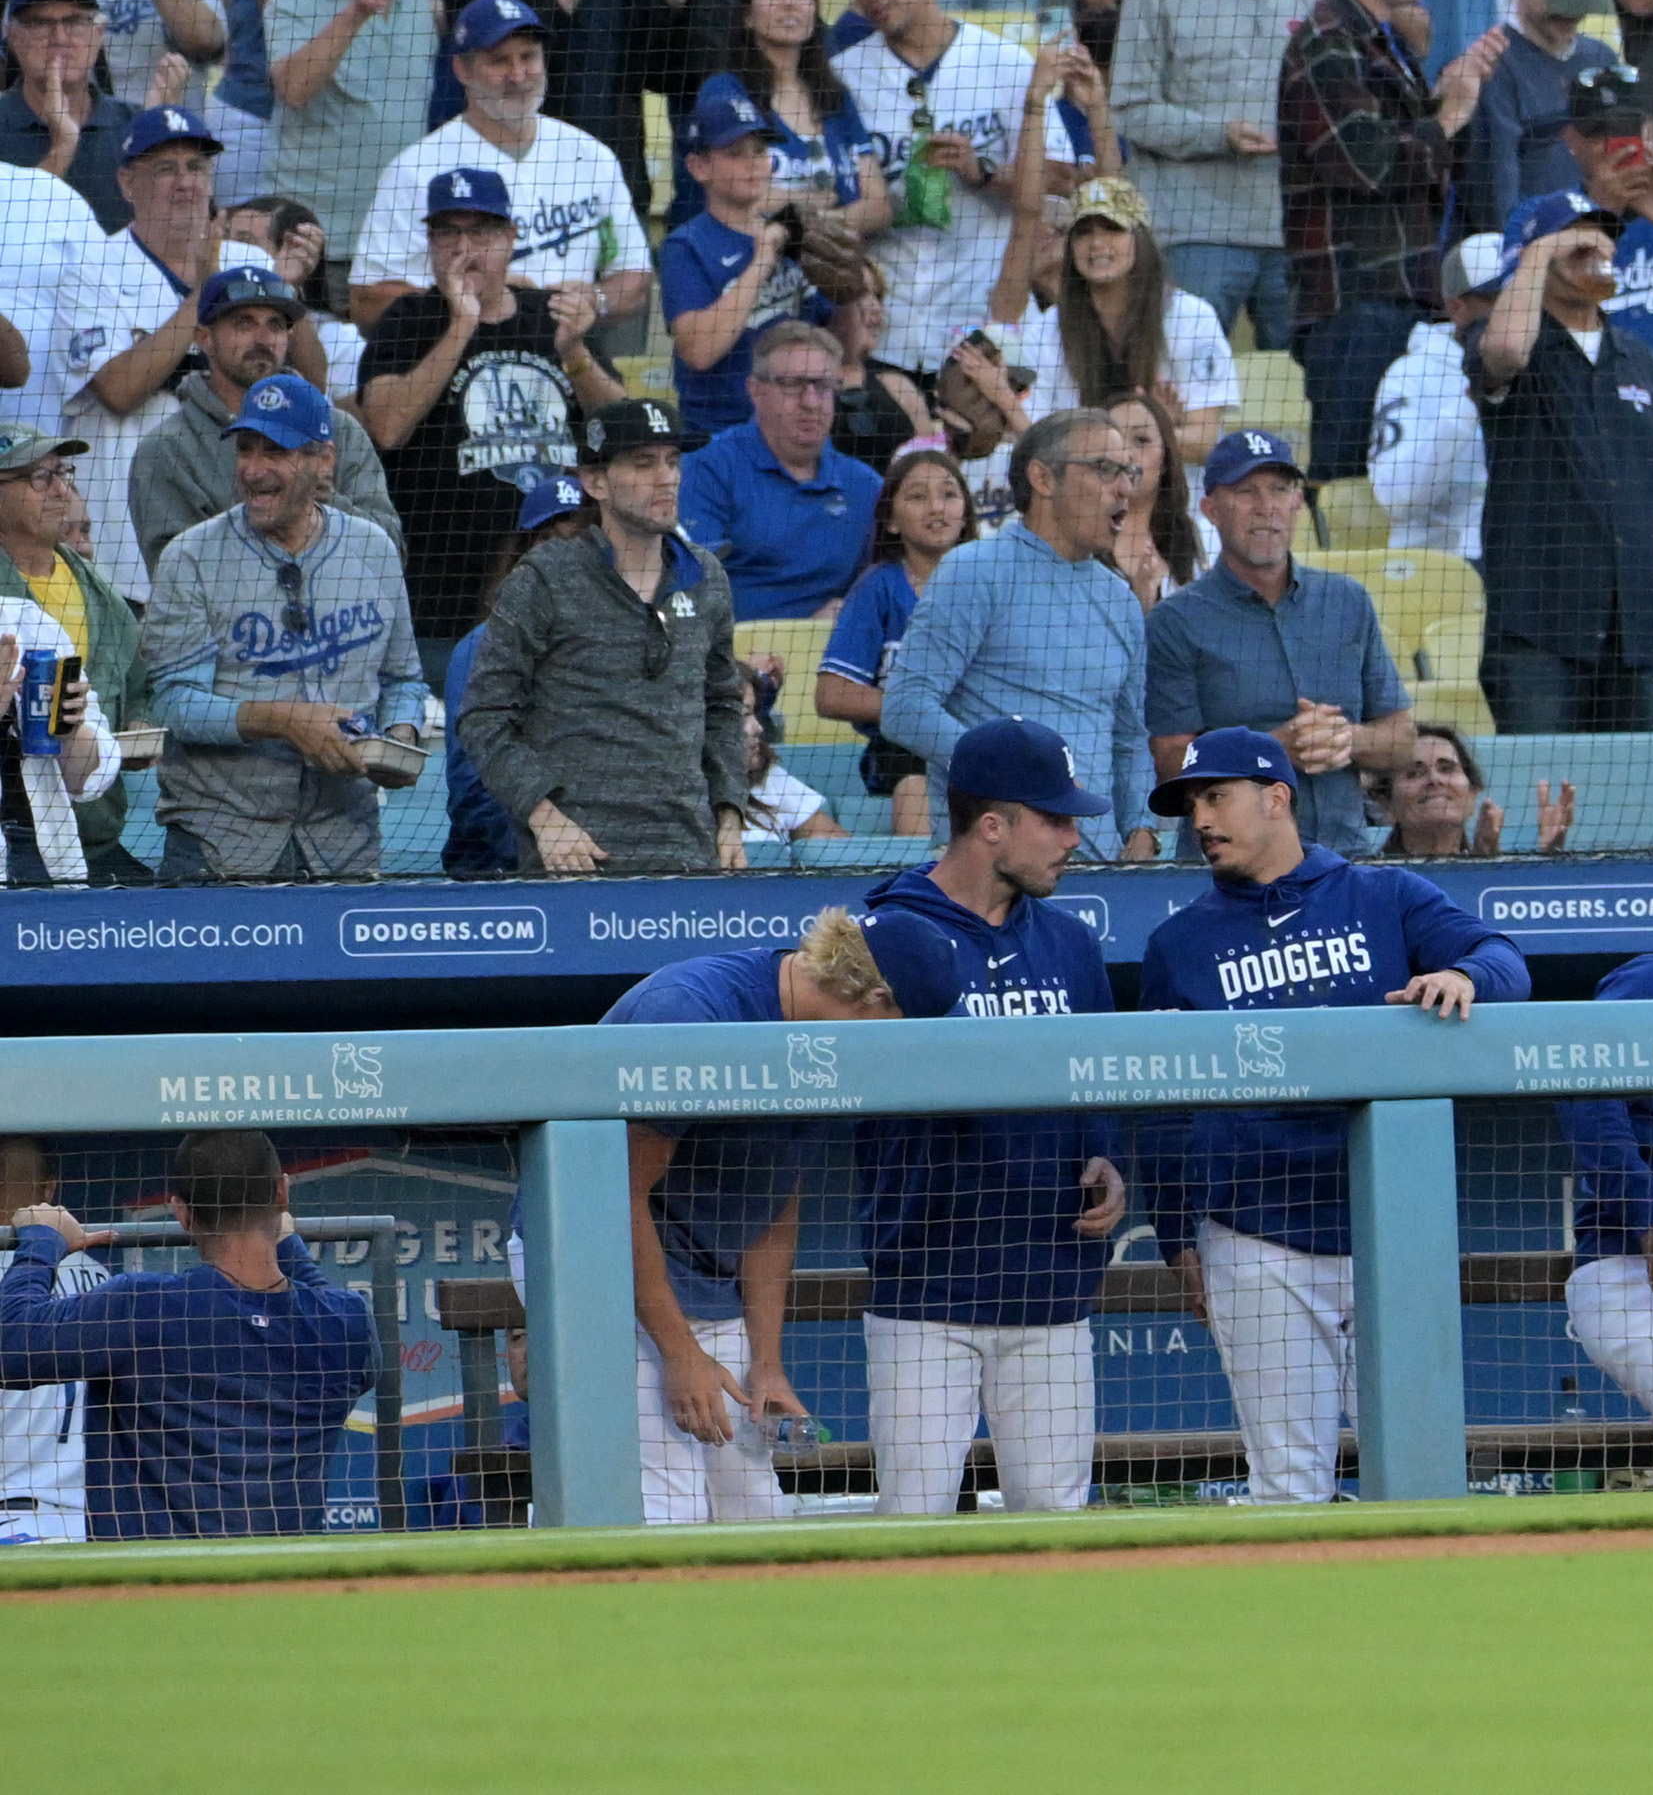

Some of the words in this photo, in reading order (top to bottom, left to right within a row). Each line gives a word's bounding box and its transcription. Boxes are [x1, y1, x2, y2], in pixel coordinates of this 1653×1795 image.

[643, 403, 671, 433] LA
[1245, 431, 1272, 455] LA
[556, 480, 581, 505] LA
[232, 600, 384, 678] Dodgers
[17, 920, 303, 952] blueshieldca.com
[355, 921, 535, 942] DODGERS.COM
[1215, 940, 1250, 961] LOS
[1270, 920, 1365, 946] ANGELES
[1218, 932, 1372, 1002] DODGERS
[618, 1065, 779, 1092] MERRILL
[1069, 1055, 1228, 1082] MERRILL
[160, 1074, 324, 1102] MERRILL
[1070, 1092, 1080, 1103] A
[1084, 1091, 1124, 1103] BANK
[1128, 1089, 1147, 1101] OF
[1151, 1088, 1229, 1101] AMERICA
[1232, 1085, 1311, 1099] COMPANY
[1515, 1079, 1526, 1090] A
[1528, 1077, 1571, 1090] BANK
[1575, 1076, 1596, 1088] OF
[161, 1113, 172, 1124] A
[175, 1111, 221, 1124] BANK
[225, 1110, 245, 1122] OF
[248, 1108, 324, 1122] AMERICA
[327, 1106, 409, 1120] COMPANY
[619, 1102, 630, 1113] A
[633, 1101, 677, 1113] BANK
[682, 1100, 702, 1112] OF
[706, 1098, 779, 1111] AMERICA
[783, 1096, 863, 1110] COMPANY
